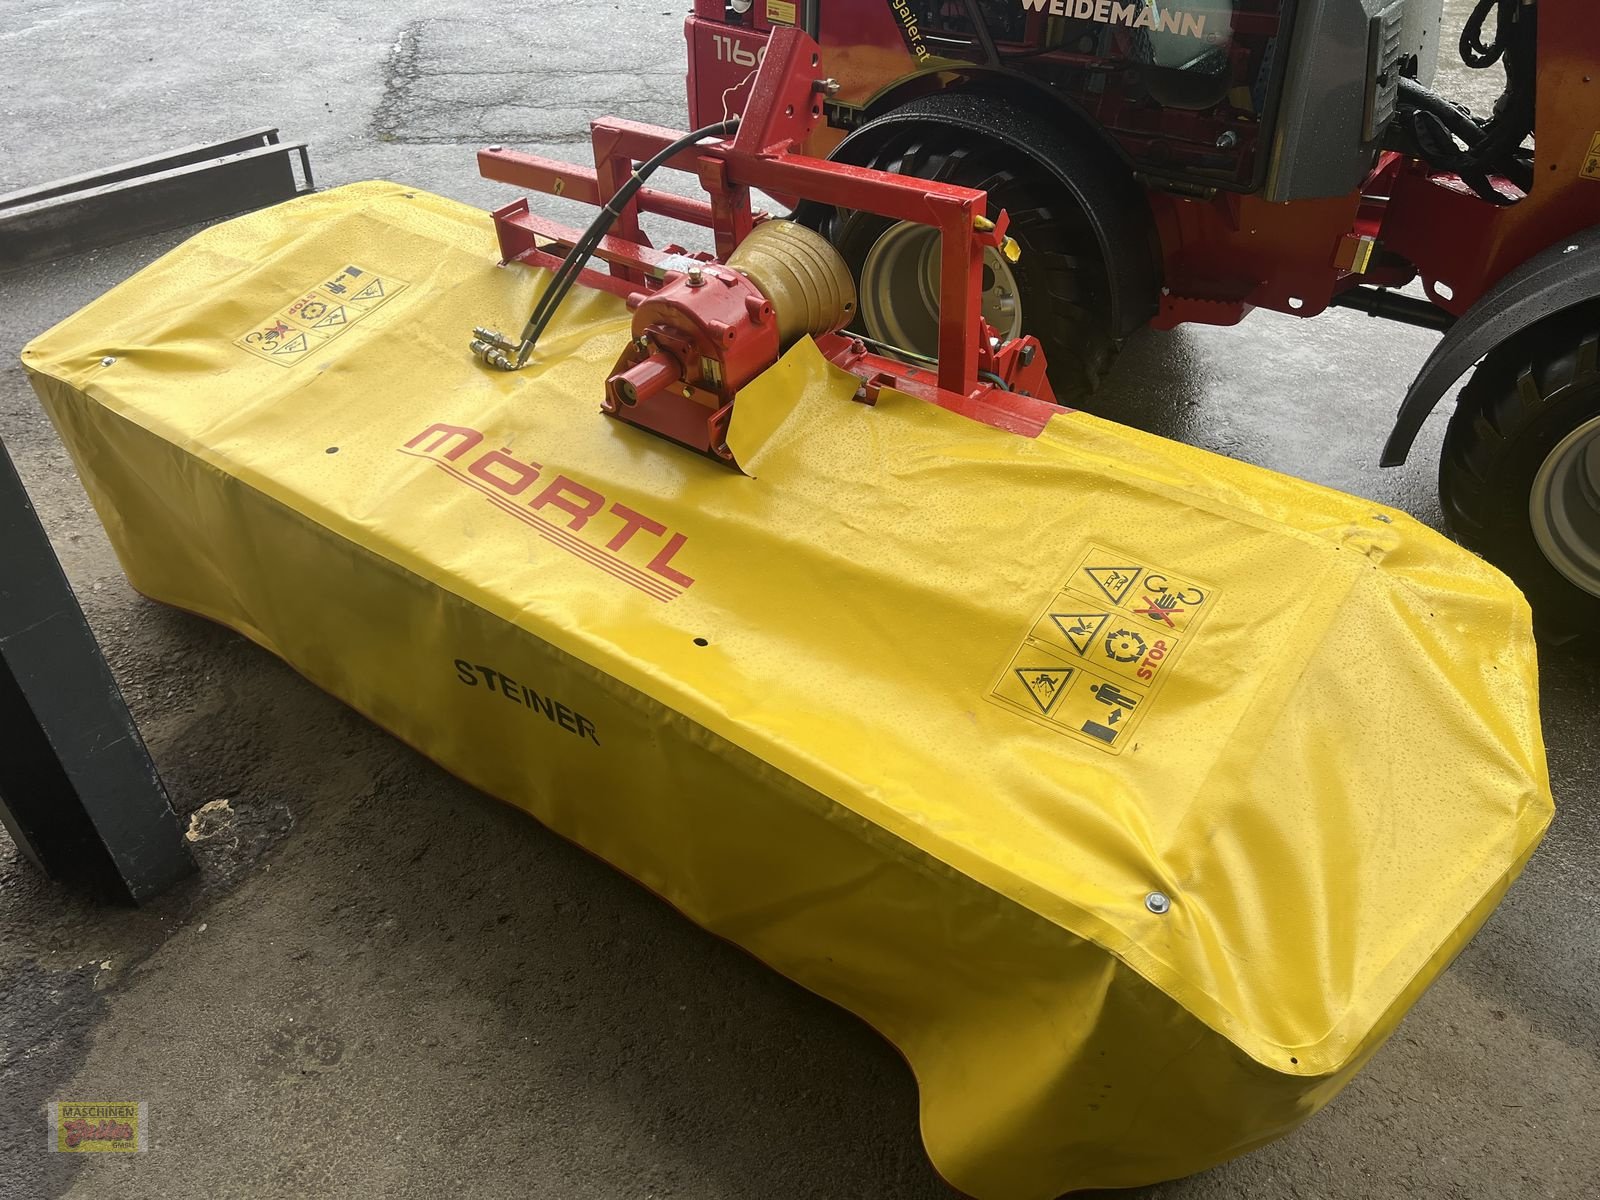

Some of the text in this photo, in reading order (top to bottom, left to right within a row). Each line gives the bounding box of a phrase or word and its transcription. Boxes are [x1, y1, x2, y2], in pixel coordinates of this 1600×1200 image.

[288, 294, 316, 315] STOP
[403, 423, 695, 588] MÖRTL
[1136, 640, 1168, 680] STOP
[454, 659, 600, 746] STEINER
